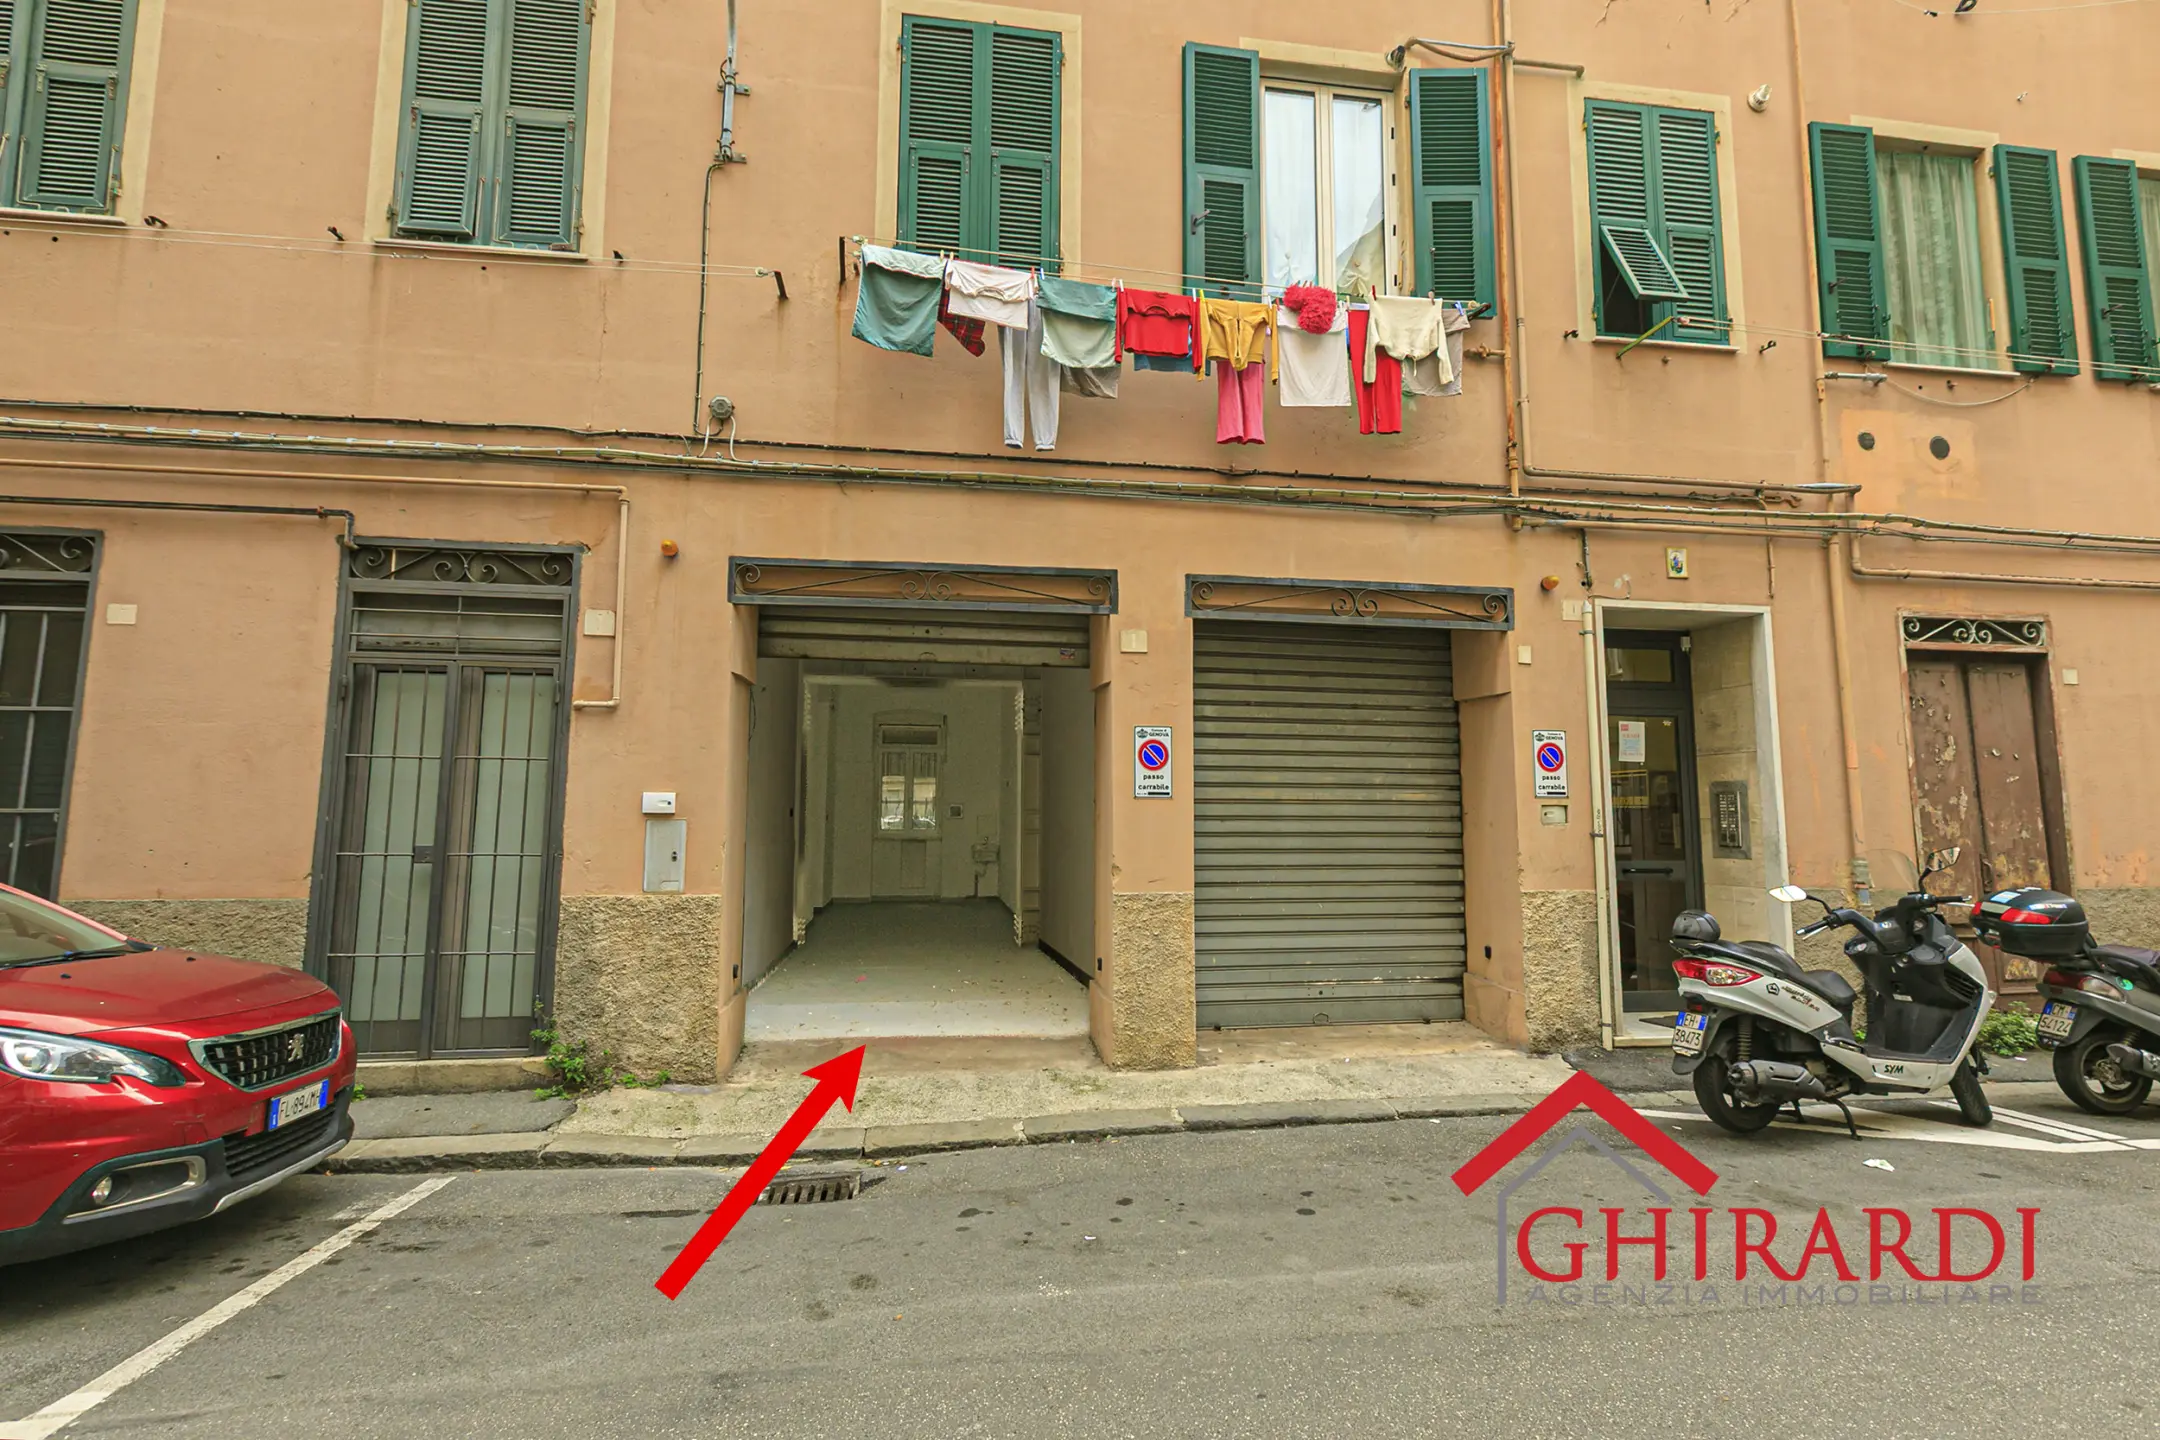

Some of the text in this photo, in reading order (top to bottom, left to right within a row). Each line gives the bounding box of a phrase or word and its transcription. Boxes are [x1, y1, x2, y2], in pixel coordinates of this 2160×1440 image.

[2040, 1016, 2072, 1033] 54124
[1675, 1028, 1702, 1046] 38473
[1884, 1064, 1904, 1074] SYM
